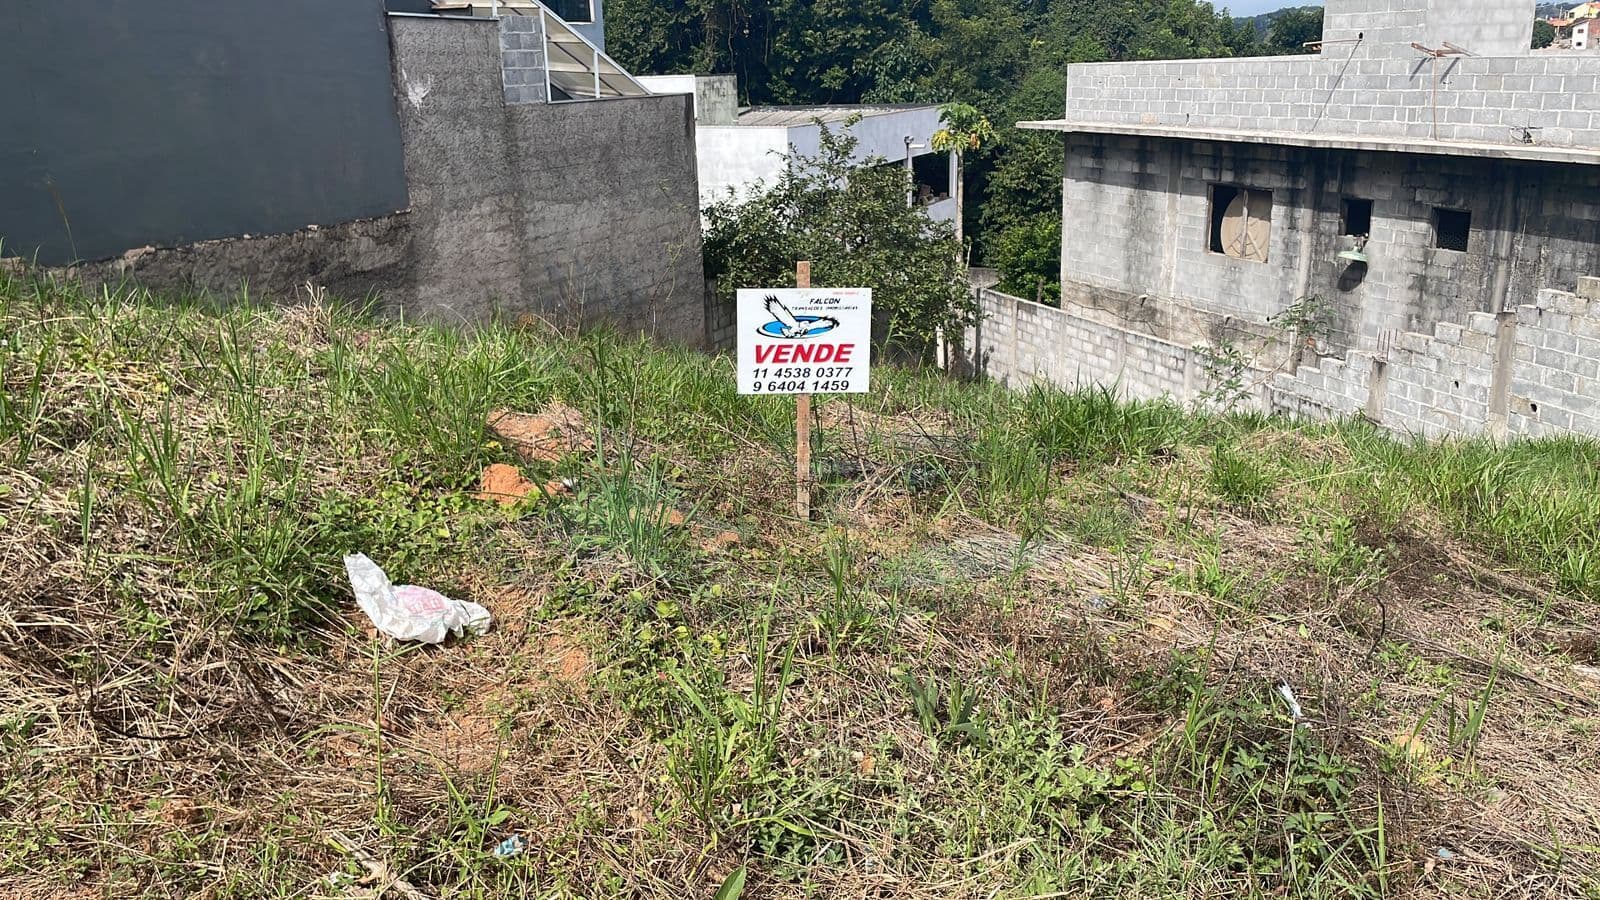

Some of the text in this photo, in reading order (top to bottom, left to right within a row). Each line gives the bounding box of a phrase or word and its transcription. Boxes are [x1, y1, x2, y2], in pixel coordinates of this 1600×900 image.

[809, 297, 841, 305] FALCON
[755, 344, 855, 364] VENDE
[753, 367, 853, 378] 11 4538 0377
[753, 380, 849, 391] 9 6404 1459
